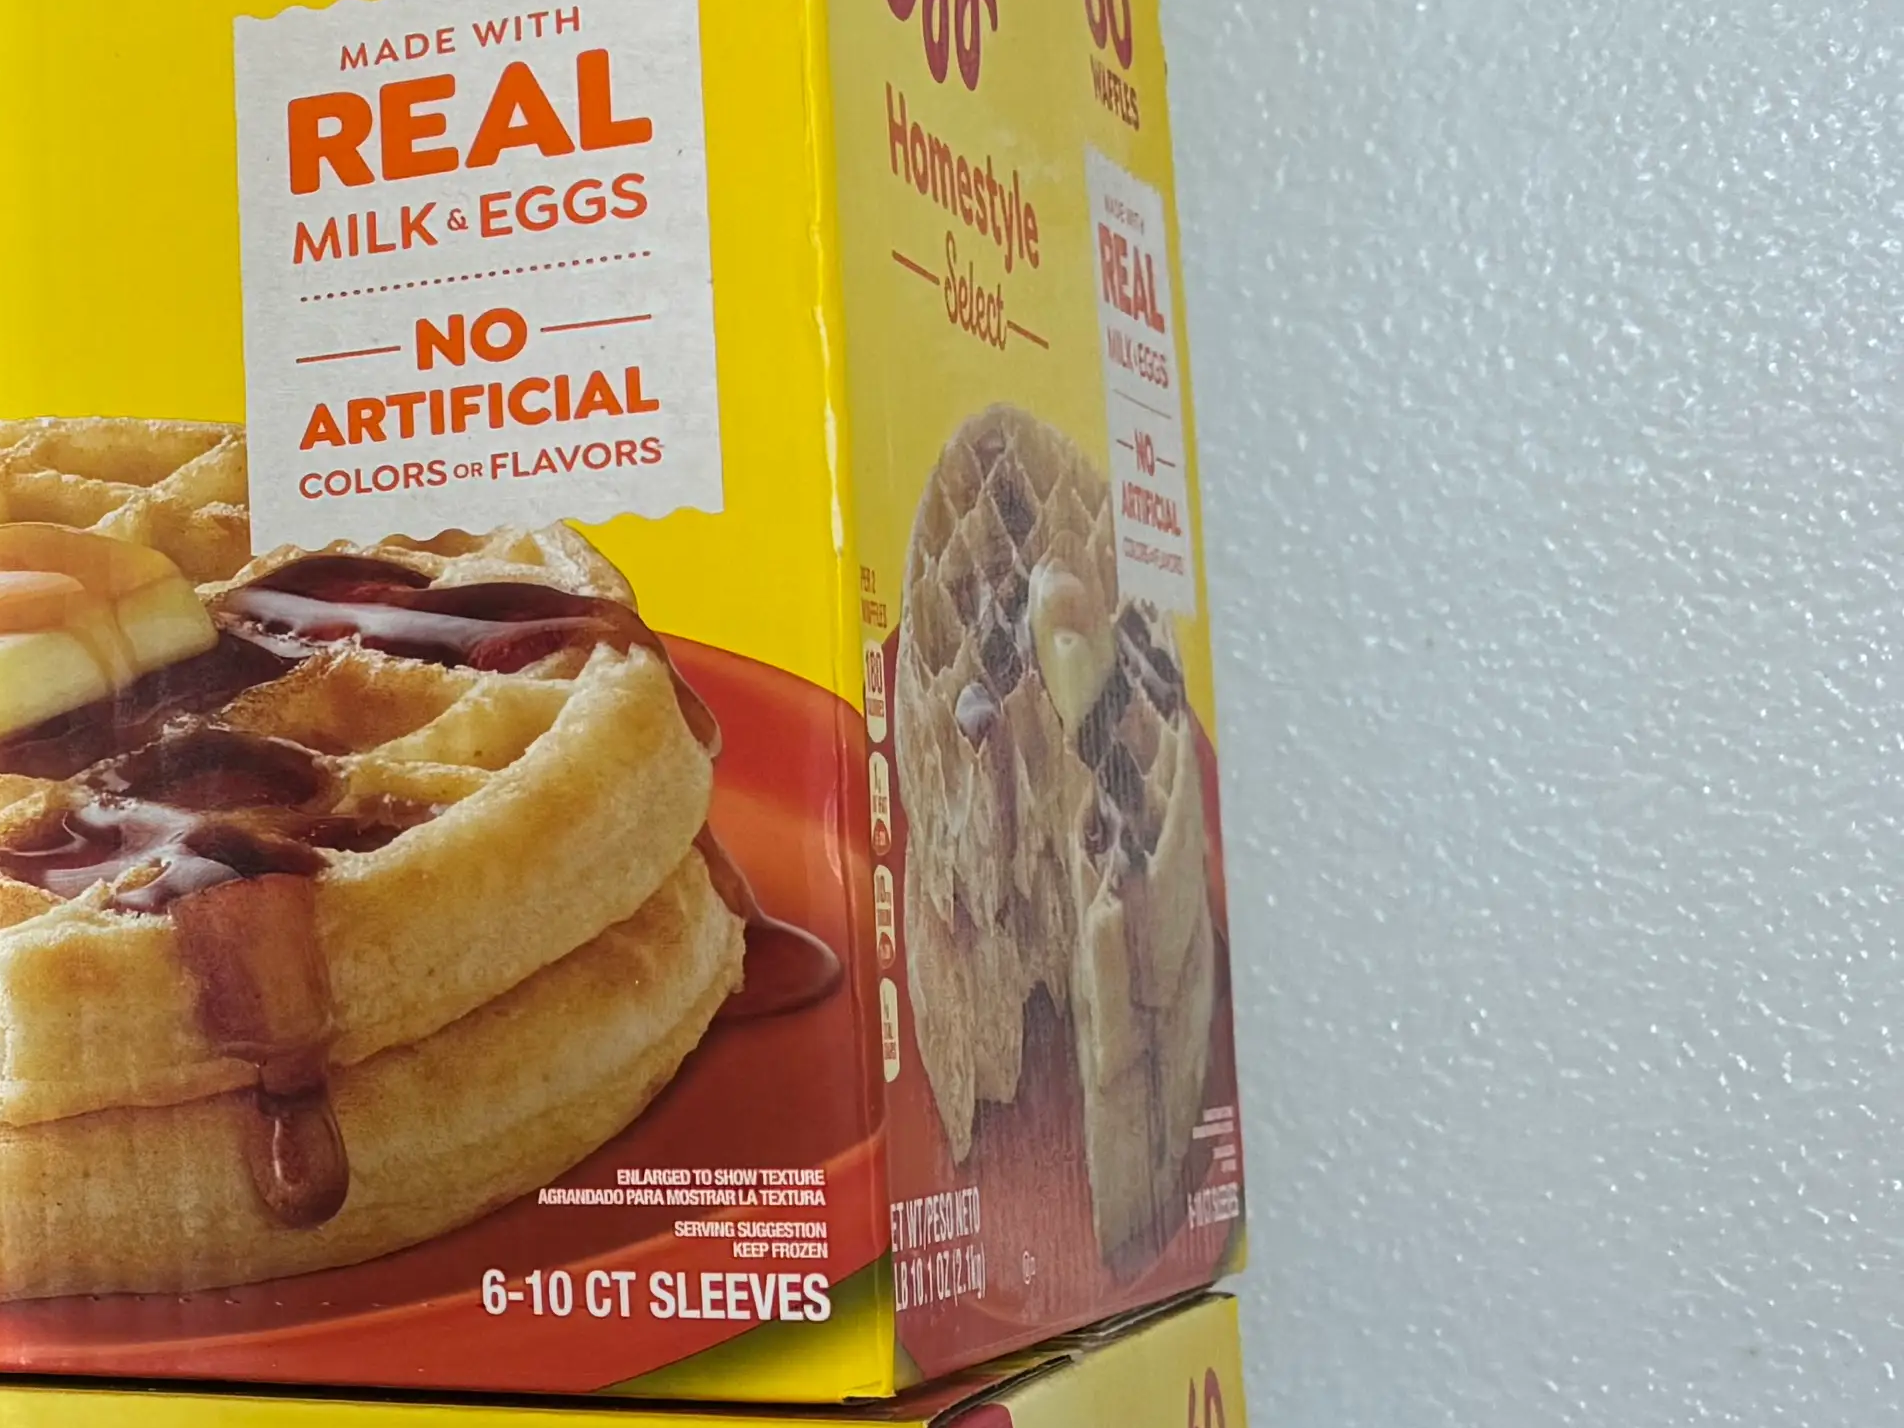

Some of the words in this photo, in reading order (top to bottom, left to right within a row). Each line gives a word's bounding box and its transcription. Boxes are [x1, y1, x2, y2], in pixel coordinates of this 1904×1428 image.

[341, 28, 455, 70] MADE
[473, 7, 579, 47] WITH
[288, 49, 652, 194] REAL
[886, 82, 1040, 274] Homestyle
[294, 202, 438, 263] MILK
[448, 209, 468, 231] &
[481, 174, 647, 237] EGGS
[944, 230, 1007, 350] Select
[1097, 221, 1165, 334] REAL
[416, 308, 527, 370] NO
[300, 367, 659, 449] ARTIFICIAL
[300, 460, 447, 498] COLORS
[454, 463, 482, 478] OR
[491, 438, 660, 479] FLAVORS
[617, 1168, 692, 1185] ENLARGED
[694, 1170, 713, 1185] TO
[714, 1169, 758, 1186] SHOW
[758, 1169, 825, 1186] TEXTURE
[674, 1221, 734, 1238] SERVING
[737, 1222, 827, 1239] SUGGESTION
[733, 1242, 768, 1258] KEEP
[771, 1242, 829, 1259] FROZEN
[480, 1268, 575, 1317] 6-10
[584, 1270, 638, 1318] CT
[648, 1271, 833, 1324] SLEEVES
